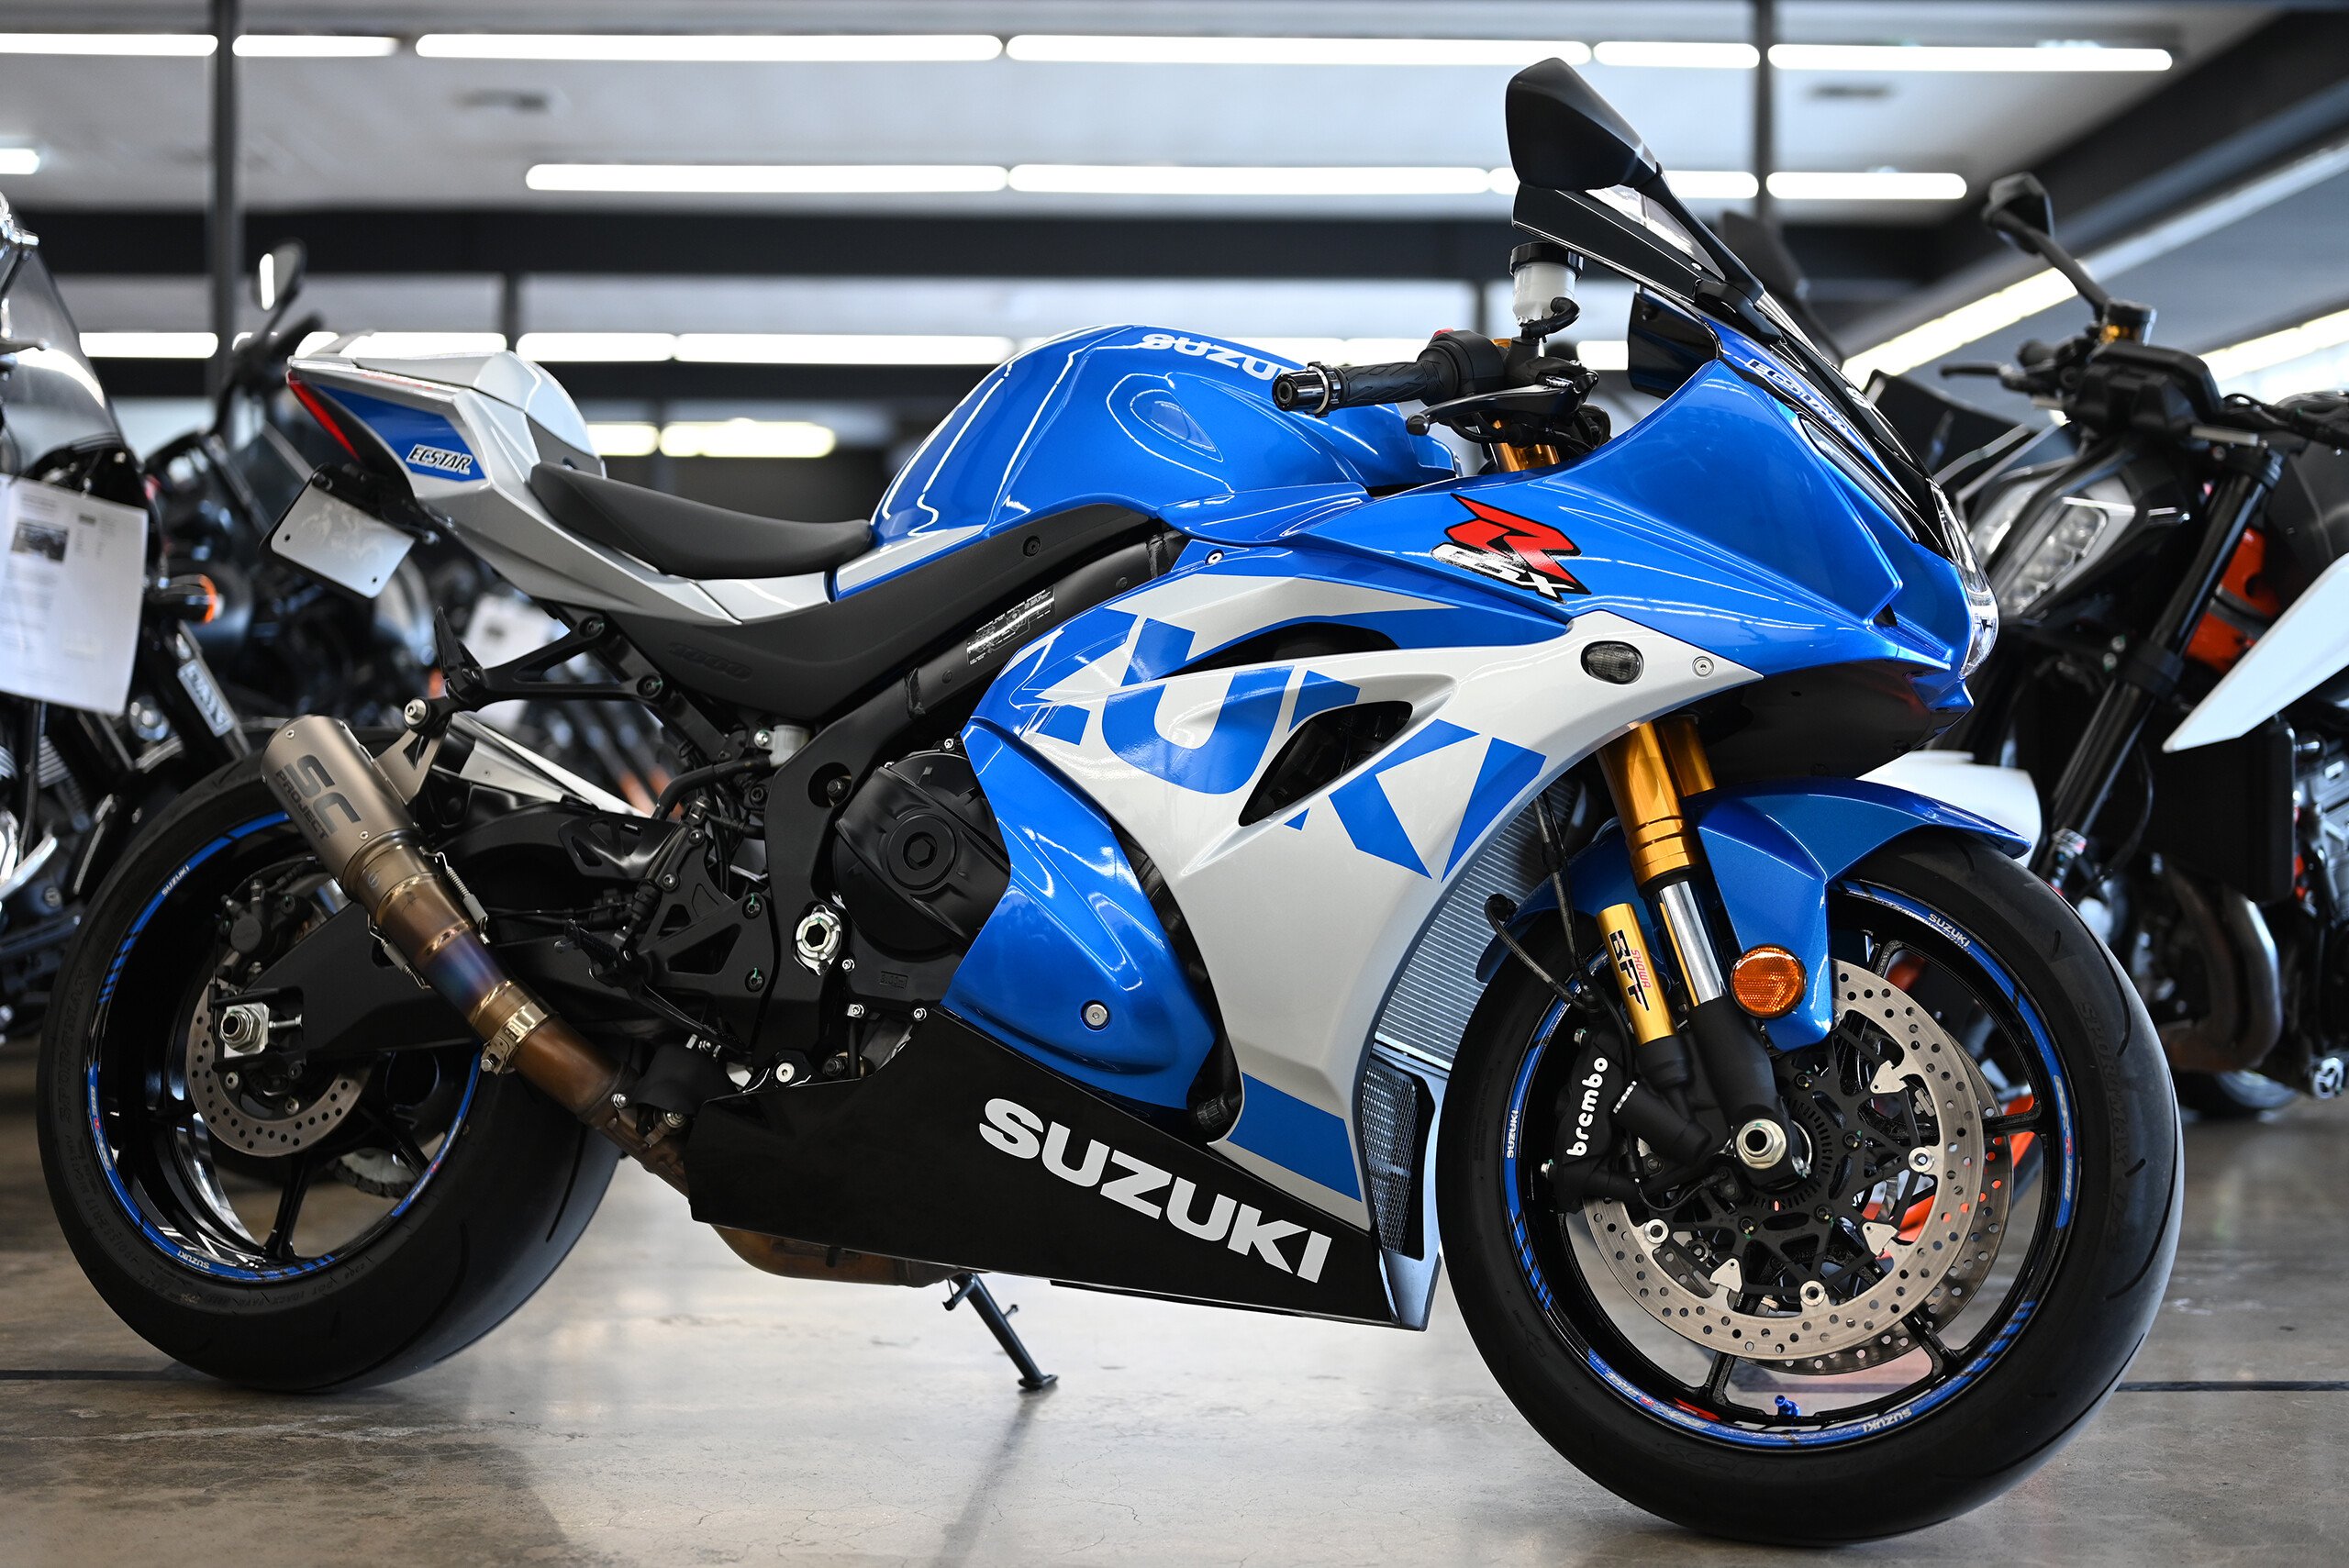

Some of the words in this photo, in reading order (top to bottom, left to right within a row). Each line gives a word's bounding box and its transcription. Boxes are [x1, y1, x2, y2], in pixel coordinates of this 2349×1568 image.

[1744, 358, 1848, 432] ECSTAR
[406, 444, 473, 474] ECSTAR
[1448, 494, 1585, 589] R
[275, 769, 329, 840] PROJECT
[284, 754, 362, 835] SC
[161, 864, 190, 896] SUZUKI
[1928, 913, 1970, 947] SUZUKI
[1631, 949, 1652, 988] SHOWA
[1565, 1057, 1609, 1156] brembo
[1507, 1109, 1520, 1159] SUZUKI
[978, 1097, 1332, 1284] SUZUKI
[177, 1250, 210, 1270] SUZUKI
[1864, 1407, 1912, 1433] SUZUKI
